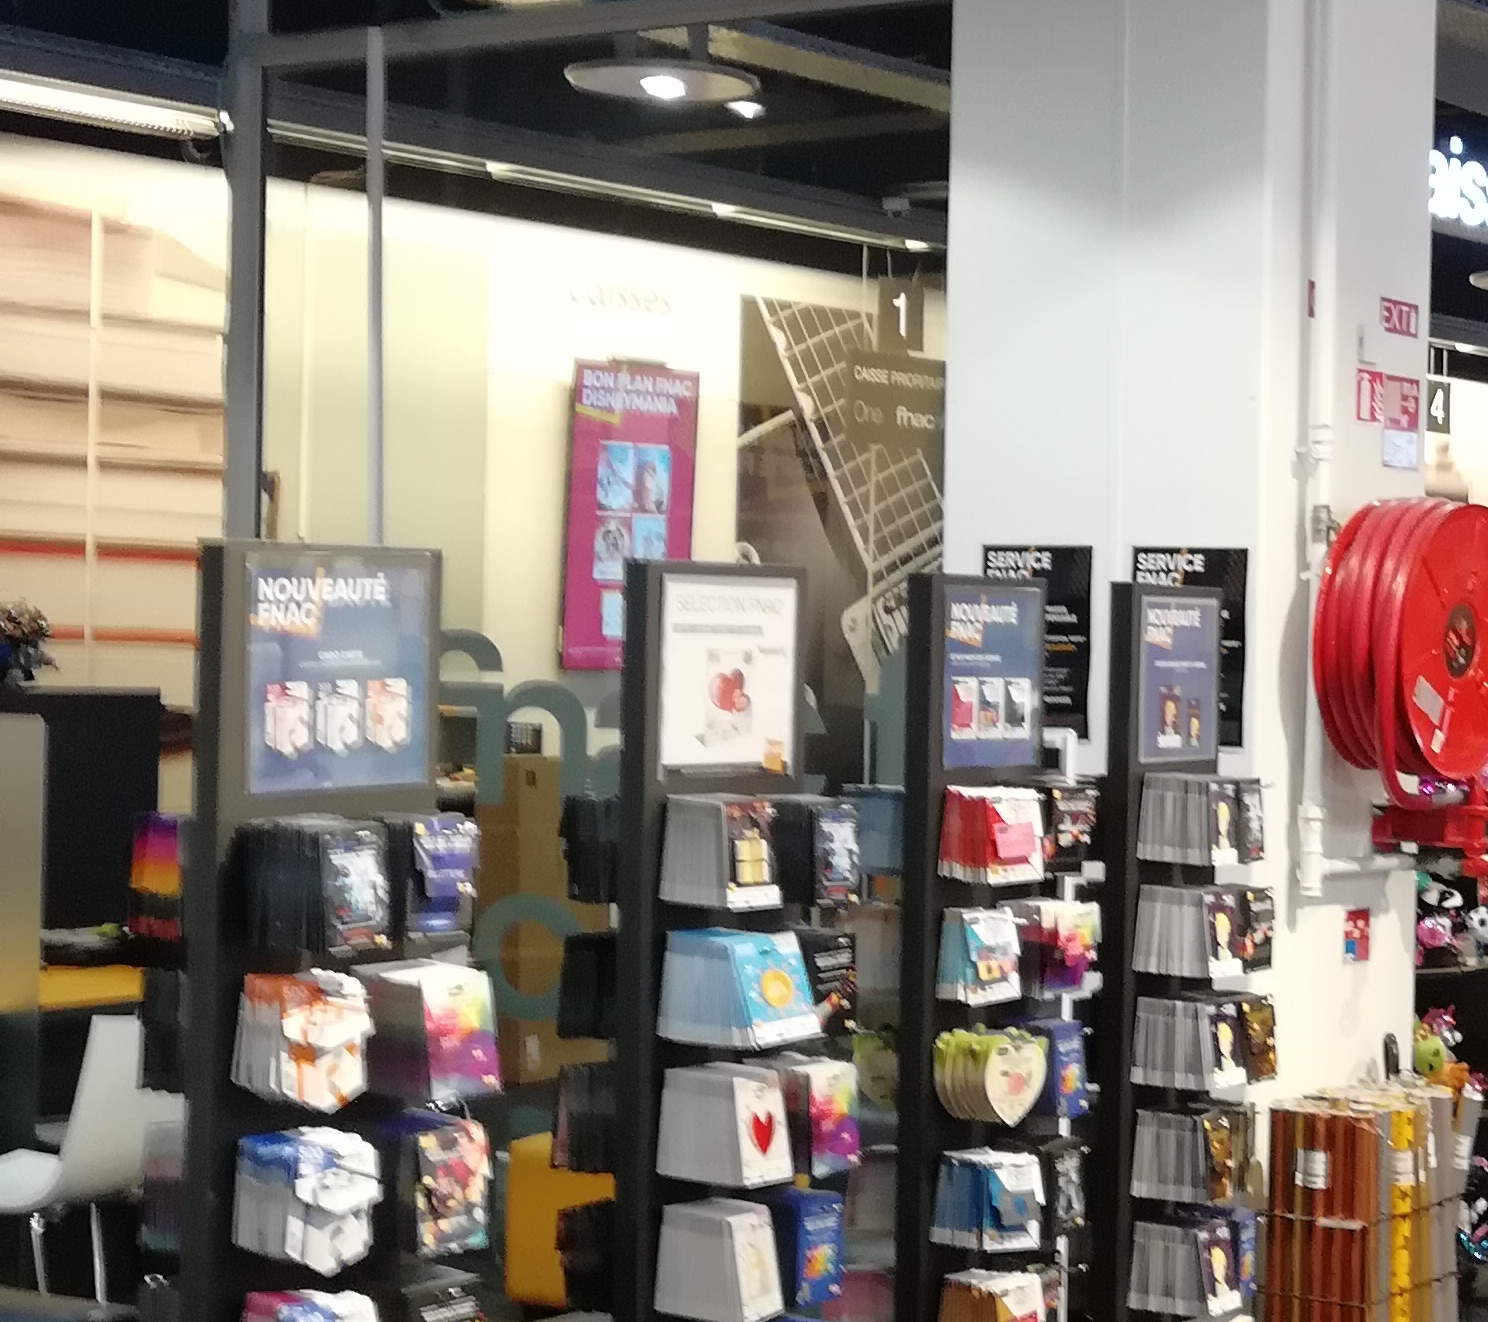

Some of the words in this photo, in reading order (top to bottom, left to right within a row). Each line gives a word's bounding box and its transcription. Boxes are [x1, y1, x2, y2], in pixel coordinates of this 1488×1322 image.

[892, 292, 906, 338] 1
[583, 369, 615, 388] BON
[618, 372, 653, 393] PLAN
[656, 376, 694, 399] FNAC
[854, 365, 889, 385] CAISSE
[896, 405, 936, 429] fnac
[1430, 388, 1446, 425] 4
[987, 551, 1052, 570] SERVICE
[1136, 553, 1205, 572] SERVICE
[257, 573, 388, 603] NOUVEAUTÉ
[257, 603, 317, 627] FNAC
